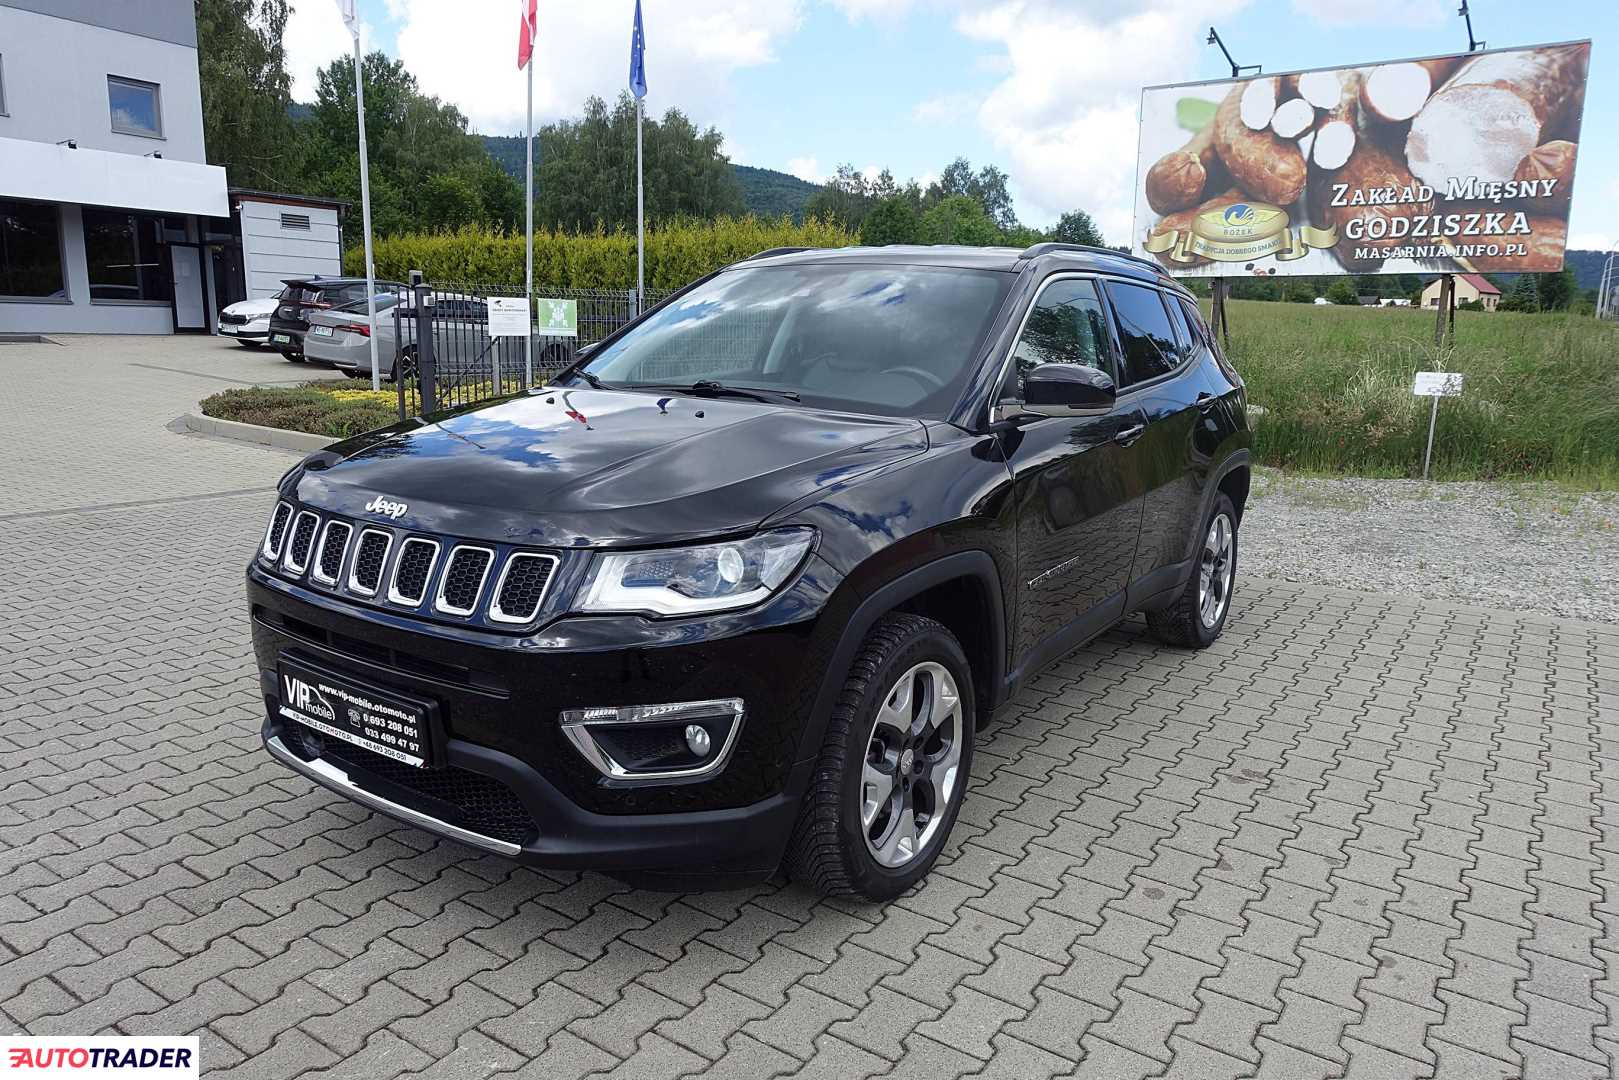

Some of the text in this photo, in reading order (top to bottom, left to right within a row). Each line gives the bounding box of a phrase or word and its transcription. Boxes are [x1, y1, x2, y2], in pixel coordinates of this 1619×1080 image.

[1345, 211, 1532, 240] GODZISZKA
[1354, 243, 1527, 260] MASARNIA.INFO.PL
[365, 495, 408, 520] Jeep
[284, 674, 310, 709] VIP
[318, 683, 417, 724] www.vip-mobile.otomoto.pl
[305, 702, 333, 720] mobile
[363, 713, 418, 739] 0 693 208 051
[364, 727, 379, 739] 033
[397, 738, 408, 748] 47
